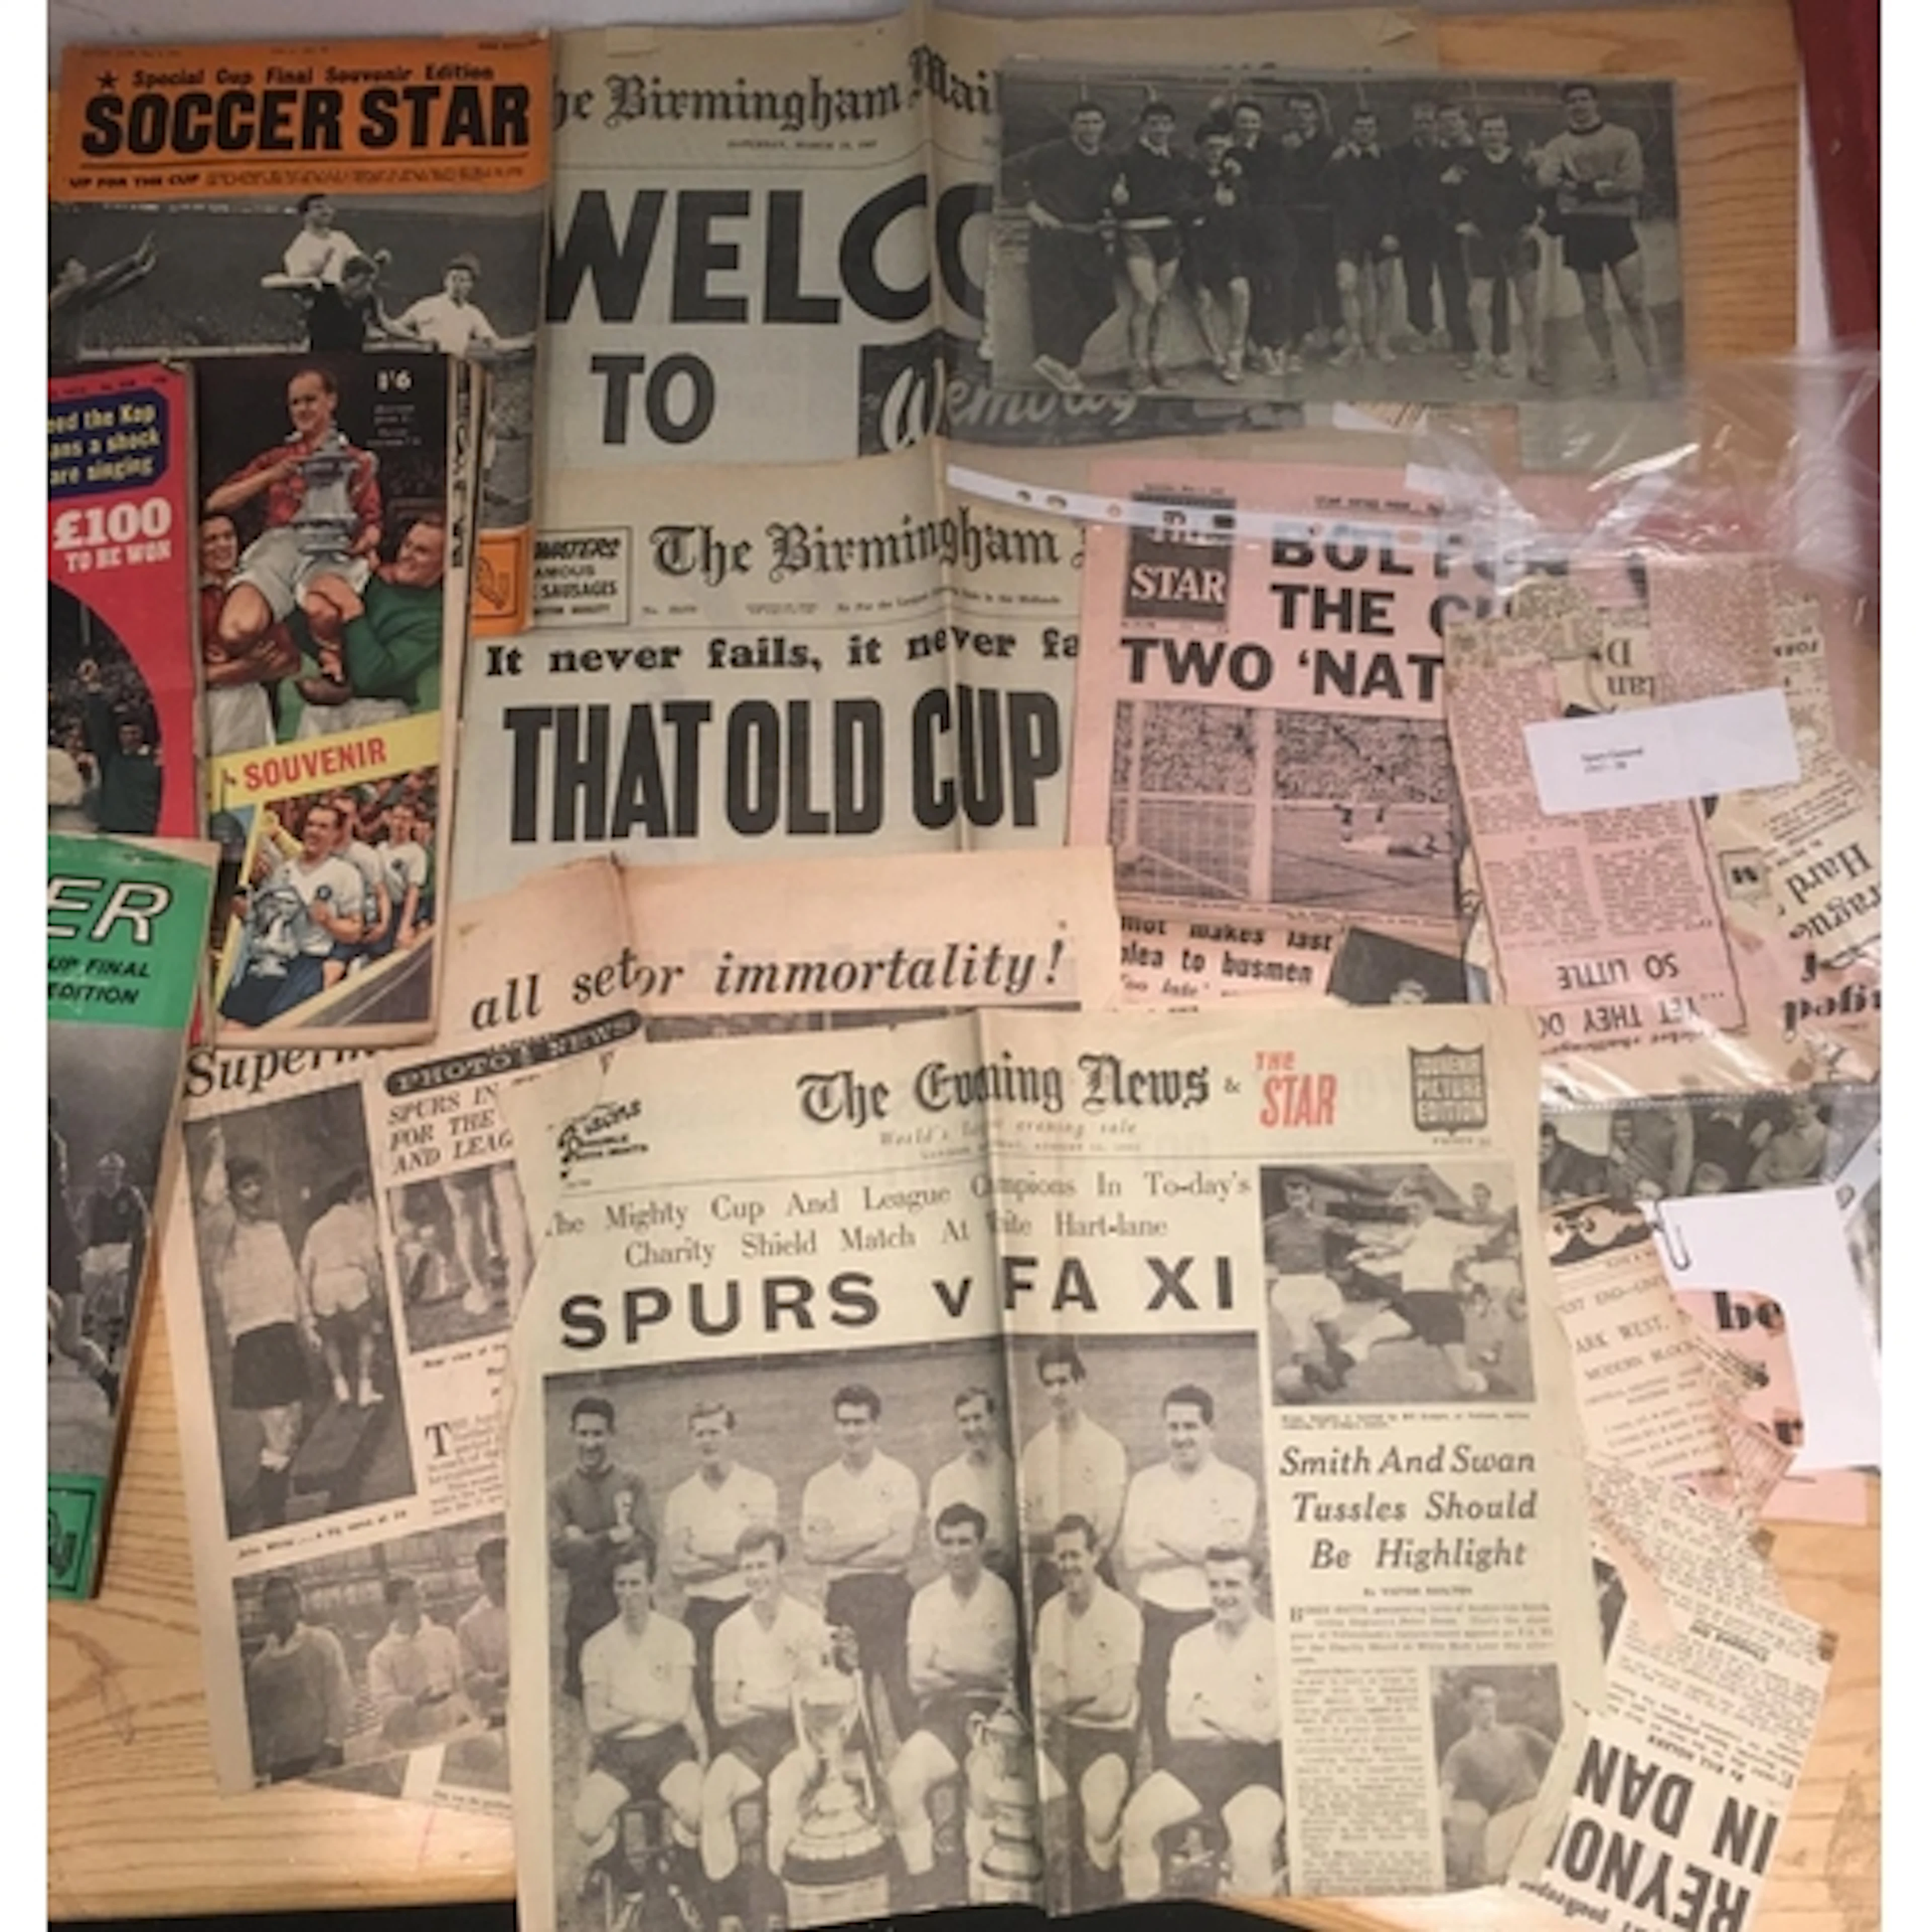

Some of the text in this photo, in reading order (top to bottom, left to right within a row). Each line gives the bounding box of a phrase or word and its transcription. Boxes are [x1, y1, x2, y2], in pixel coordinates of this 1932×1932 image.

[133, 62, 494, 89] Special Cup Final Souvenir Edition
[604, 73, 902, 131] Birmingham
[908, 42, 992, 117] Mai
[82, 85, 529, 157] SOCCER STAR
[69, 176, 92, 188] UP
[97, 176, 127, 188] FOR
[134, 176, 162, 187] THE
[170, 173, 199, 186] CUP
[84, 408, 115, 429] the
[119, 404, 156, 425] Kop
[591, 352, 716, 445] TO
[88, 439, 102, 455] a
[107, 428, 160, 453] shock
[49, 456, 154, 486] are singing
[53, 497, 172, 551] £100
[651, 505, 1060, 587] The Birmingham
[65, 539, 172, 573] TO BE WON
[540, 580, 618, 599] SAUSAGES
[1130, 564, 1227, 603] STAR
[1269, 583, 1396, 637] THE
[487, 645, 523, 676] It
[549, 645, 683, 674] never
[708, 637, 822, 673] fails,
[848, 634, 882, 666] it
[907, 626, 1016, 660] never
[1120, 636, 1273, 692] TWO
[244, 737, 387, 791] SOUVENIR
[503, 683, 1062, 845] THAT OLD CUP
[1785, 842, 1874, 903] Hard
[48, 874, 173, 947] ER
[1189, 923, 1265, 945] makes
[1286, 930, 1333, 951] last
[85, 959, 150, 980] FINAL
[470, 939, 1065, 1030] all set or immortality!
[1181, 949, 1205, 973] to
[1221, 950, 1313, 985] busmen
[1557, 953, 1679, 990] SO LITTLE
[48, 981, 139, 1005] EDITION
[1583, 1002, 1643, 1033] THEY
[183, 1048, 377, 1098] Super
[398, 1051, 512, 1091] PHOTO
[1255, 1051, 1295, 1071] THE
[386, 1083, 498, 1128] SPURS IN
[796, 1050, 1242, 1129] The Evning News &
[1259, 1073, 1338, 1128] STAR
[389, 1109, 495, 1152] FOR THE
[1100, 1119, 1136, 1136] sale
[392, 1128, 514, 1174] AND LEAG
[545, 1170, 1252, 1238] he Mighty Cup And League Cmpions In To-day's
[625, 1210, 1168, 1268] Charity Shield Match At ite Hart-lane
[559, 1255, 1233, 1351] SPURS v FA XI
[1279, 1443, 1536, 1476] Smith And Swan
[1293, 1488, 1538, 1523] Tussles Should
[1310, 1536, 1527, 1573] Be Highlight
[1573, 1737, 1779, 1875] IN DAN
[1547, 1814, 1751, 1932] REYNO
